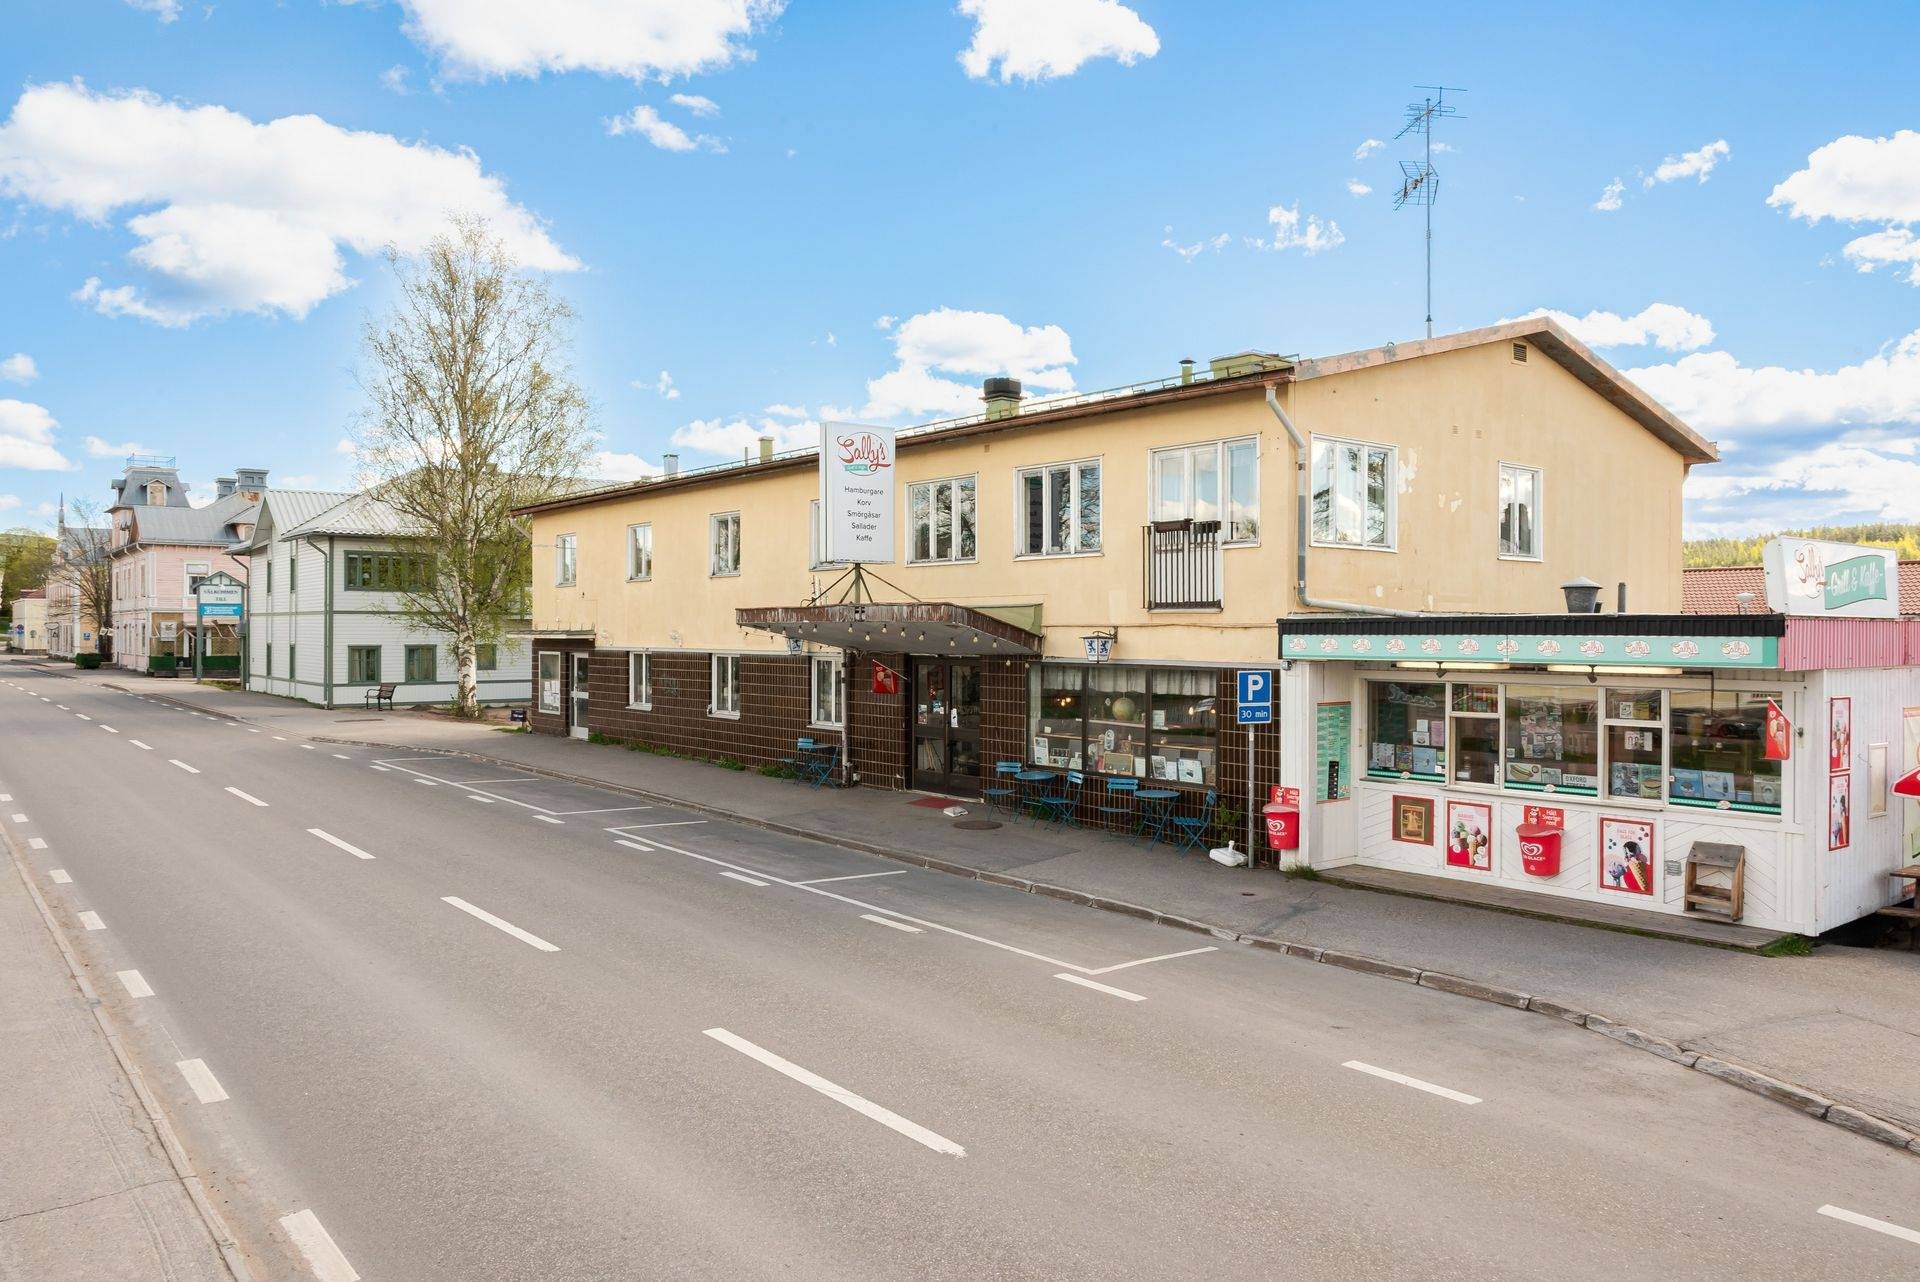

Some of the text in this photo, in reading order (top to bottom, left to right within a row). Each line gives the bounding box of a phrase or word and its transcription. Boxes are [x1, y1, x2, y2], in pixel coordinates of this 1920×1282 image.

[836, 435, 891, 472] Sally's
[844, 485, 884, 496] Hamburgare
[857, 498, 872, 506] Korv
[847, 509, 881, 519] Smörgåsar
[851, 521, 877, 530] Sallader
[856, 534, 873, 542] Kaffe
[1247, 674, 1264, 701] P
[1241, 710, 1268, 718] 30 min
